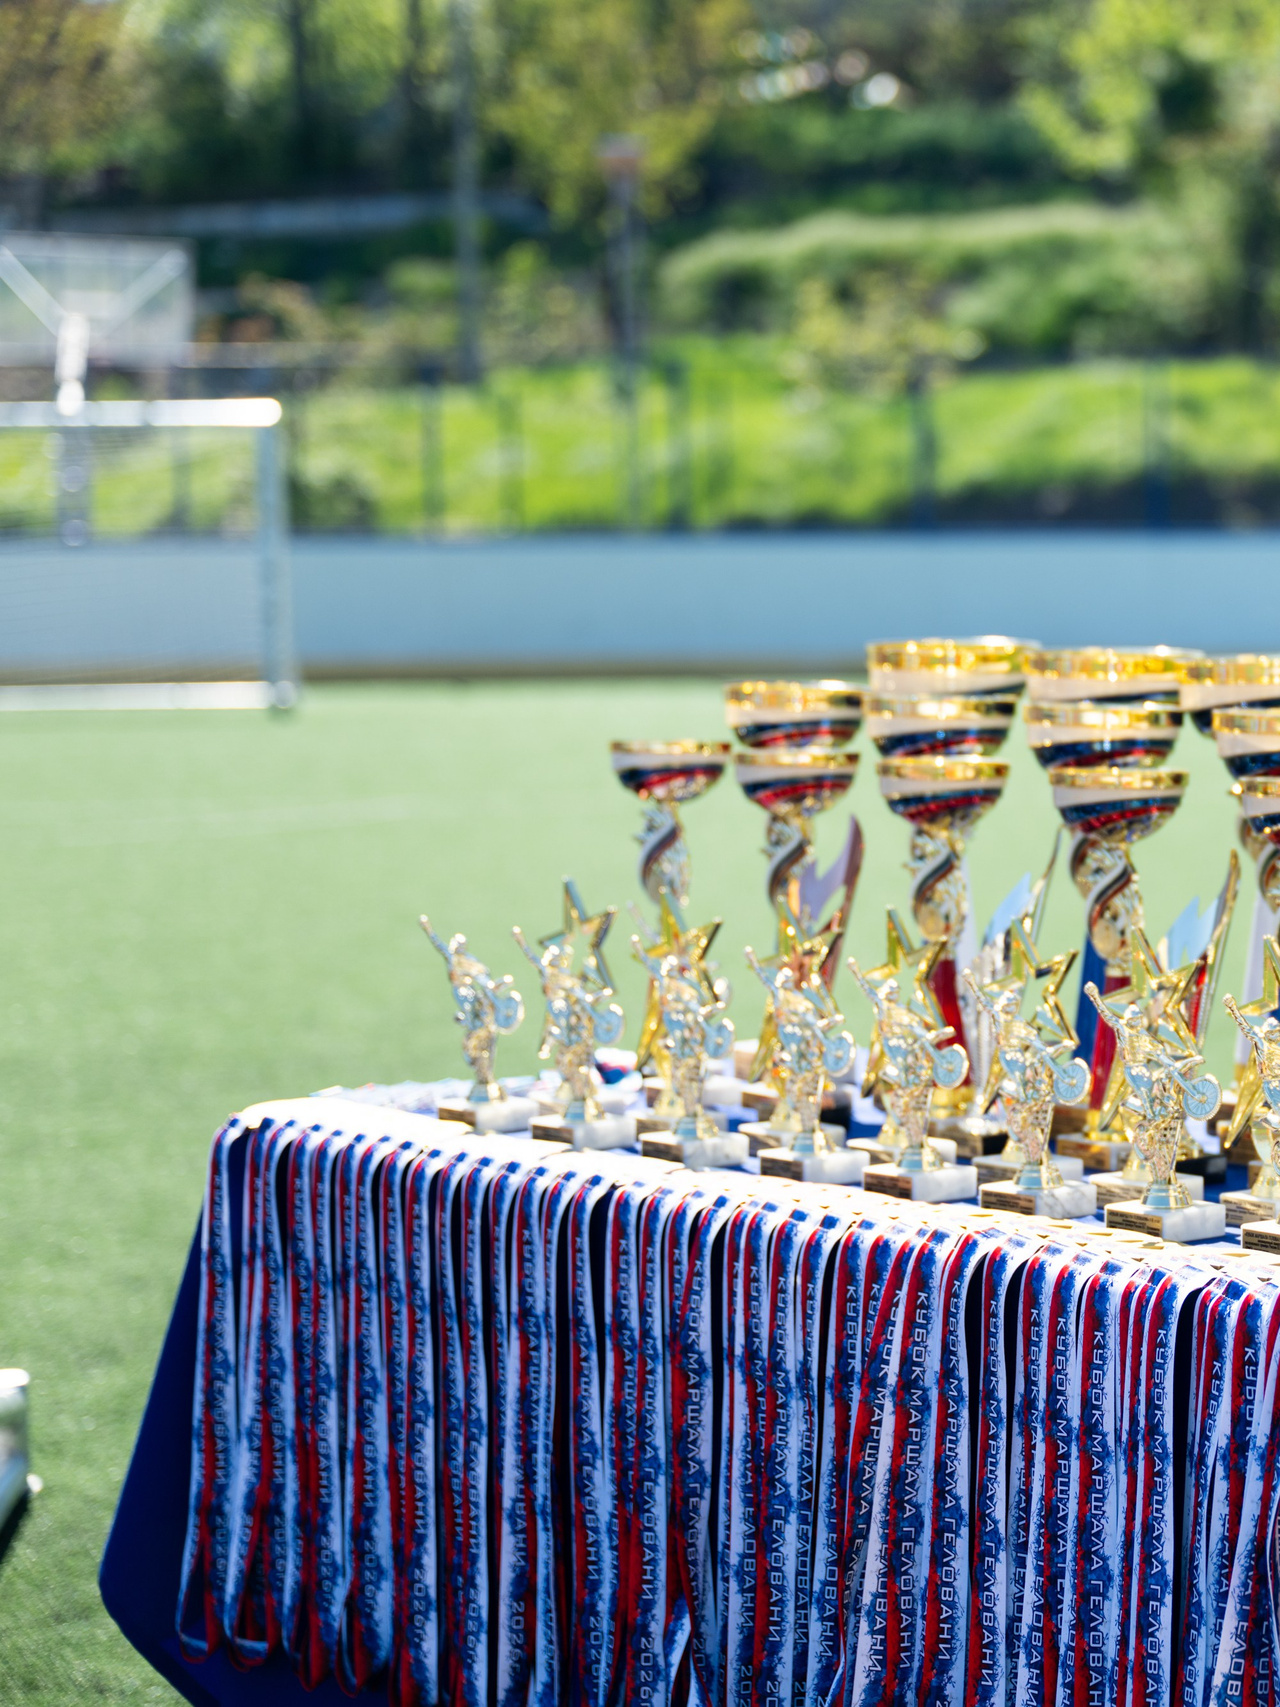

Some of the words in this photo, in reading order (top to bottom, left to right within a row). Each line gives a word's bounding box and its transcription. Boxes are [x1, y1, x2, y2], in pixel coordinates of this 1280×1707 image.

[522, 1229, 536, 1311] КУБОК
[575, 1237, 587, 1320] КУБОК
[618, 1239, 631, 1326] КУБОК
[645, 1247, 655, 1333] КУБОК
[687, 1260, 703, 1350] КУБОК
[750, 1266, 763, 1353] КУБОК
[775, 1277, 788, 1362] КУБОК
[846, 1286, 857, 1372] КУБОК
[949, 1280, 961, 1373] КУБОК
[578, 1327, 592, 1445] МАРШАЛА
[911, 1292, 928, 1386] КУБОК
[989, 1300, 1000, 1391] КУБОК
[1030, 1308, 1040, 1399] КУБОК
[1056, 1318, 1069, 1410] КУБОК
[1092, 1331, 1104, 1426] КУБОК
[1154, 1330, 1167, 1426] КУБОК
[645, 1338, 657, 1460] МАРШАЛА
[687, 1353, 701, 1475] МАРШАЛА
[774, 1372, 787, 1496] МАРШАЛА
[860, 1387, 886, 1516] МАРШАЛА
[903, 1390, 924, 1517] МАРШАЛА
[944, 1379, 960, 1509] МАРШАЛА
[1203, 1361, 1222, 1457] КУБОК
[582, 1452, 600, 1580] ГЕЛОВАНИ
[985, 1400, 1001, 1532] МАРШАЛА
[1056, 1419, 1070, 1555] МАРШАЛА
[1090, 1435, 1104, 1571] МАРШАЛА
[1151, 1435, 1163, 1574] МАРШАЛА
[641, 1467, 656, 1600] ГЕЛОВАНИ
[768, 1505, 786, 1642] ГЕЛОВАНИ
[938, 1517, 956, 1660] ГЕЛОВАНИ
[899, 1527, 916, 1668] ГЕЛОВАНИ
[981, 1541, 996, 1686] ГЕЛОВАНИ
